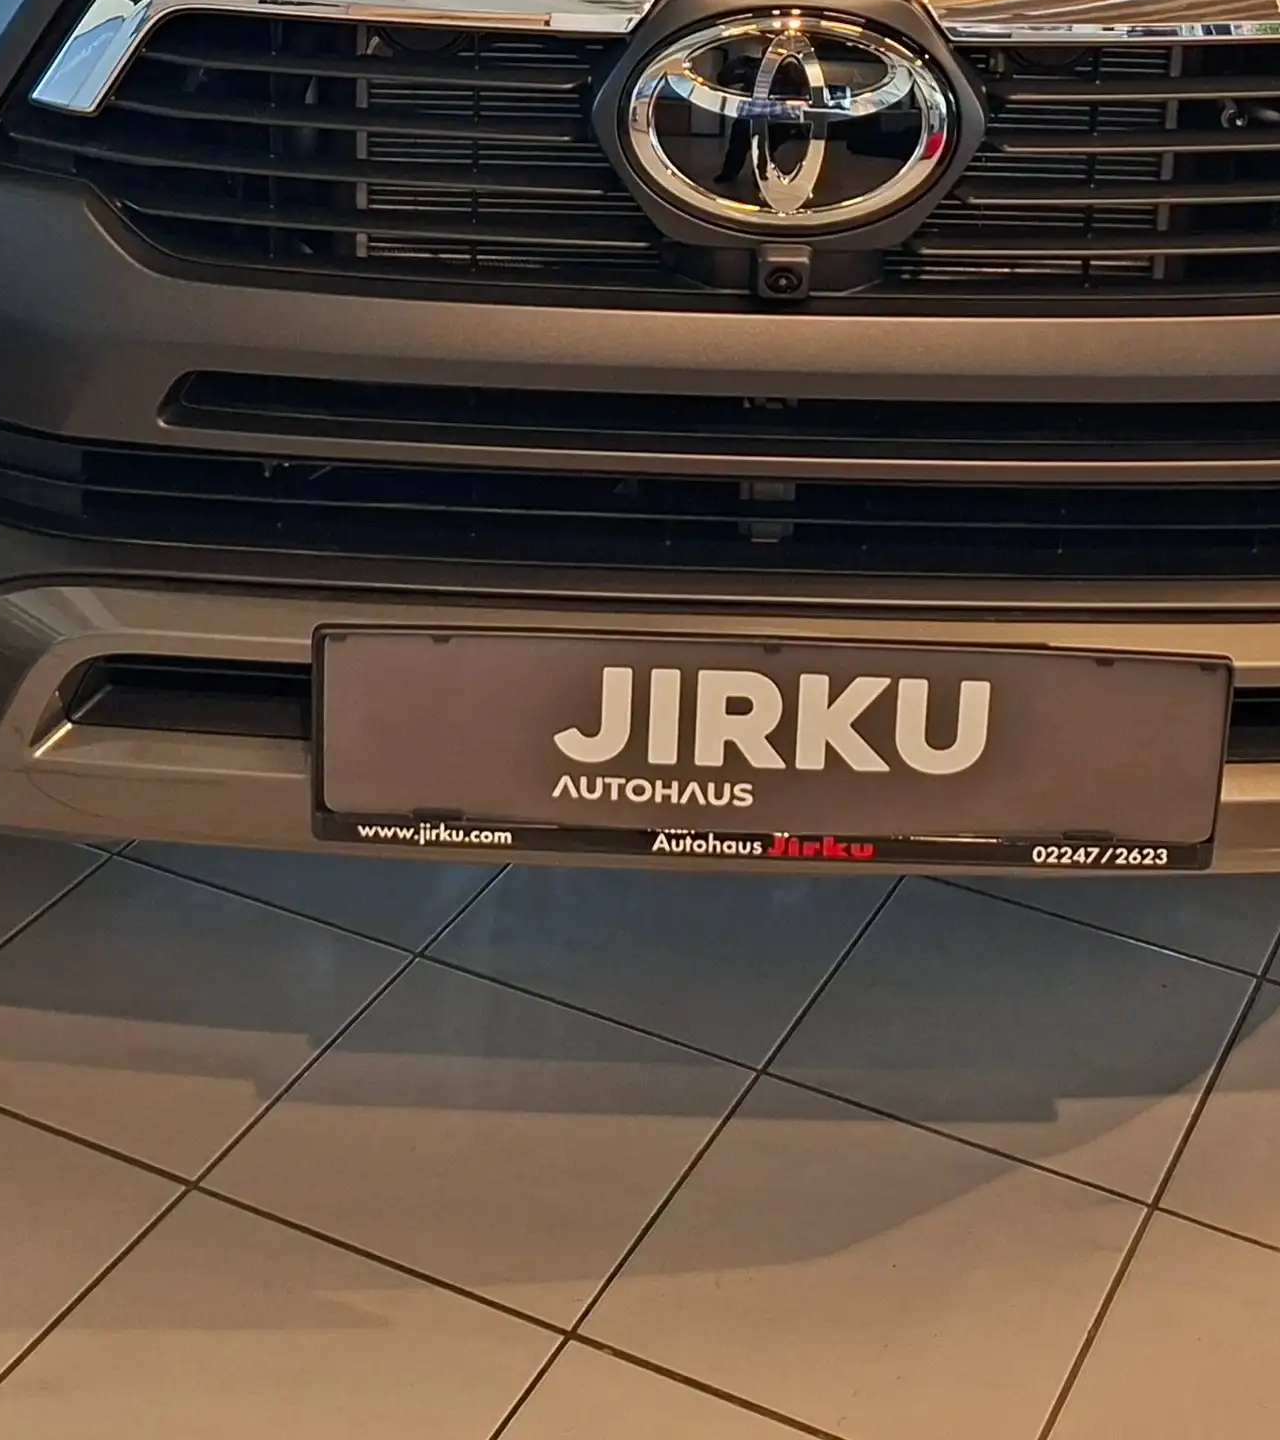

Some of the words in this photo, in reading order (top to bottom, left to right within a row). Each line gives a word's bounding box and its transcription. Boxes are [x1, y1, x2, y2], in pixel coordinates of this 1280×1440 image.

[552, 666, 992, 775] JIRKU
[551, 774, 755, 808] AUTOHAUS
[356, 821, 513, 846] www.jirku.com
[651, 832, 763, 856] Autohaus
[767, 834, 876, 858] Jirku
[1031, 845, 1169, 865] 02247/2623
